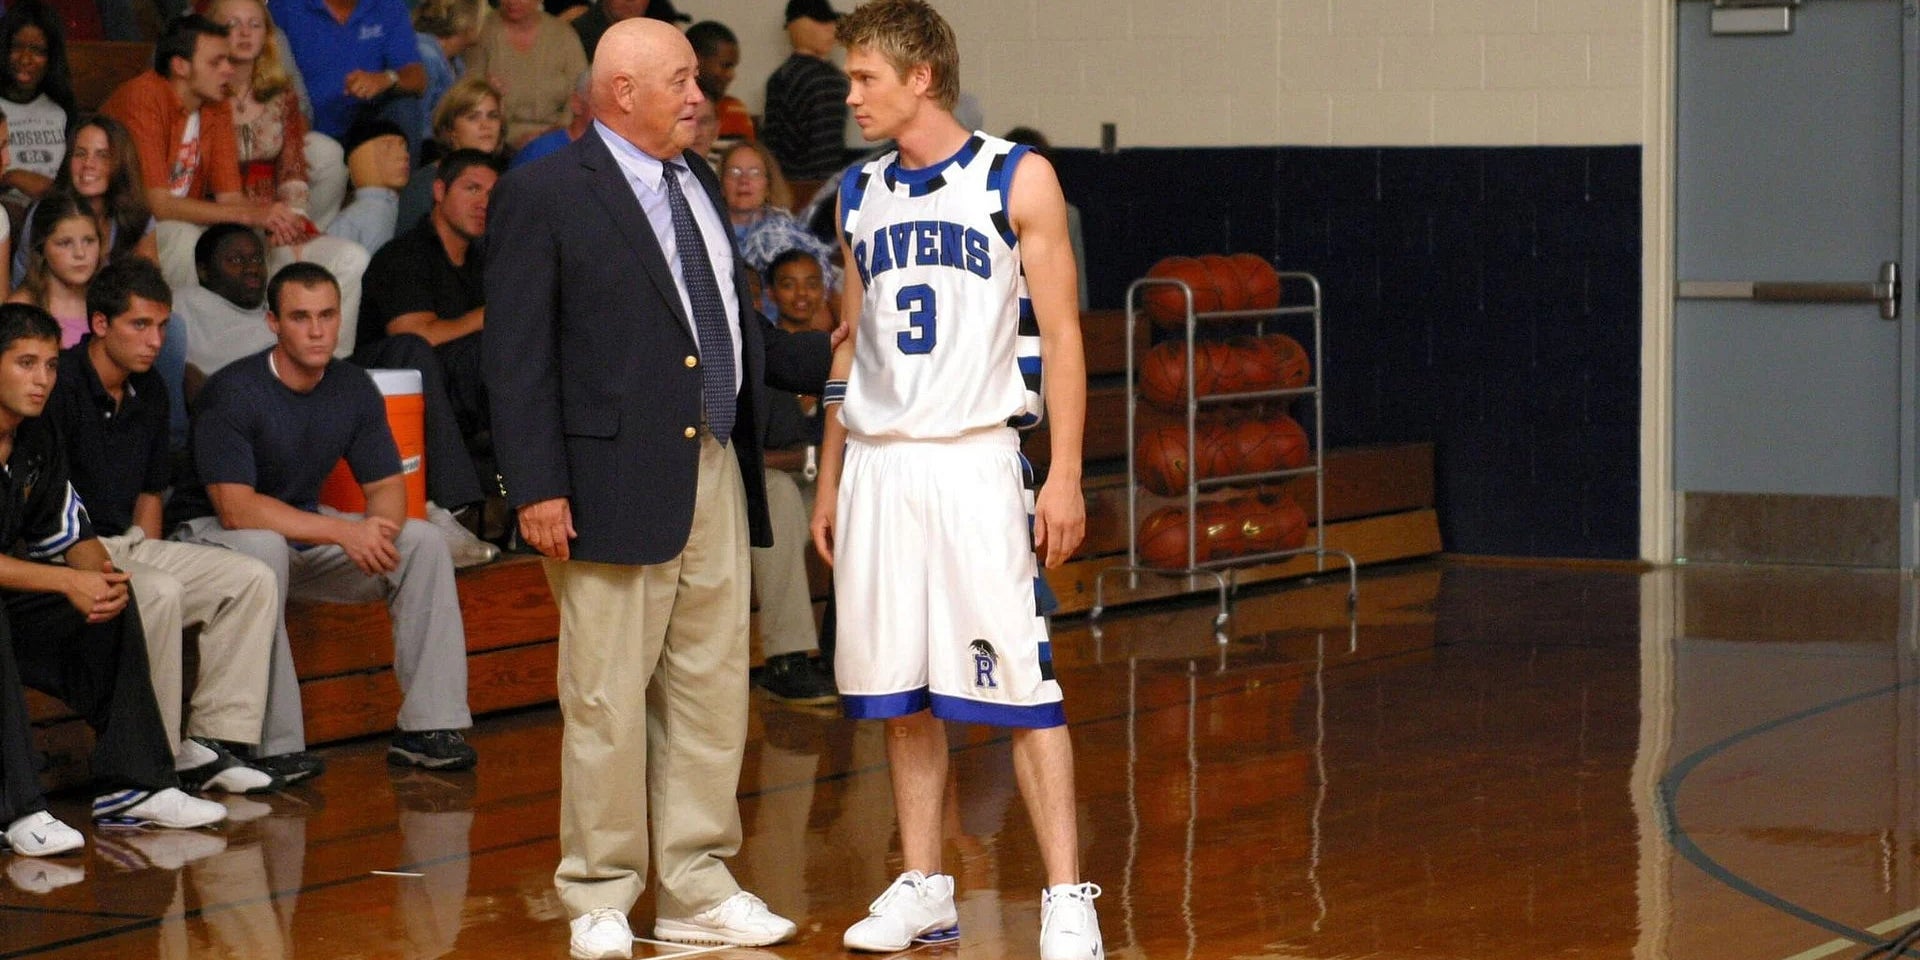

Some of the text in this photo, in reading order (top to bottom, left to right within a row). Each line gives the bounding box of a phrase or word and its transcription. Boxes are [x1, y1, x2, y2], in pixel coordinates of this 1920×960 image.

[854, 220, 992, 292] RAVENS
[896, 283, 937, 355] 3
[974, 653, 998, 688] R
